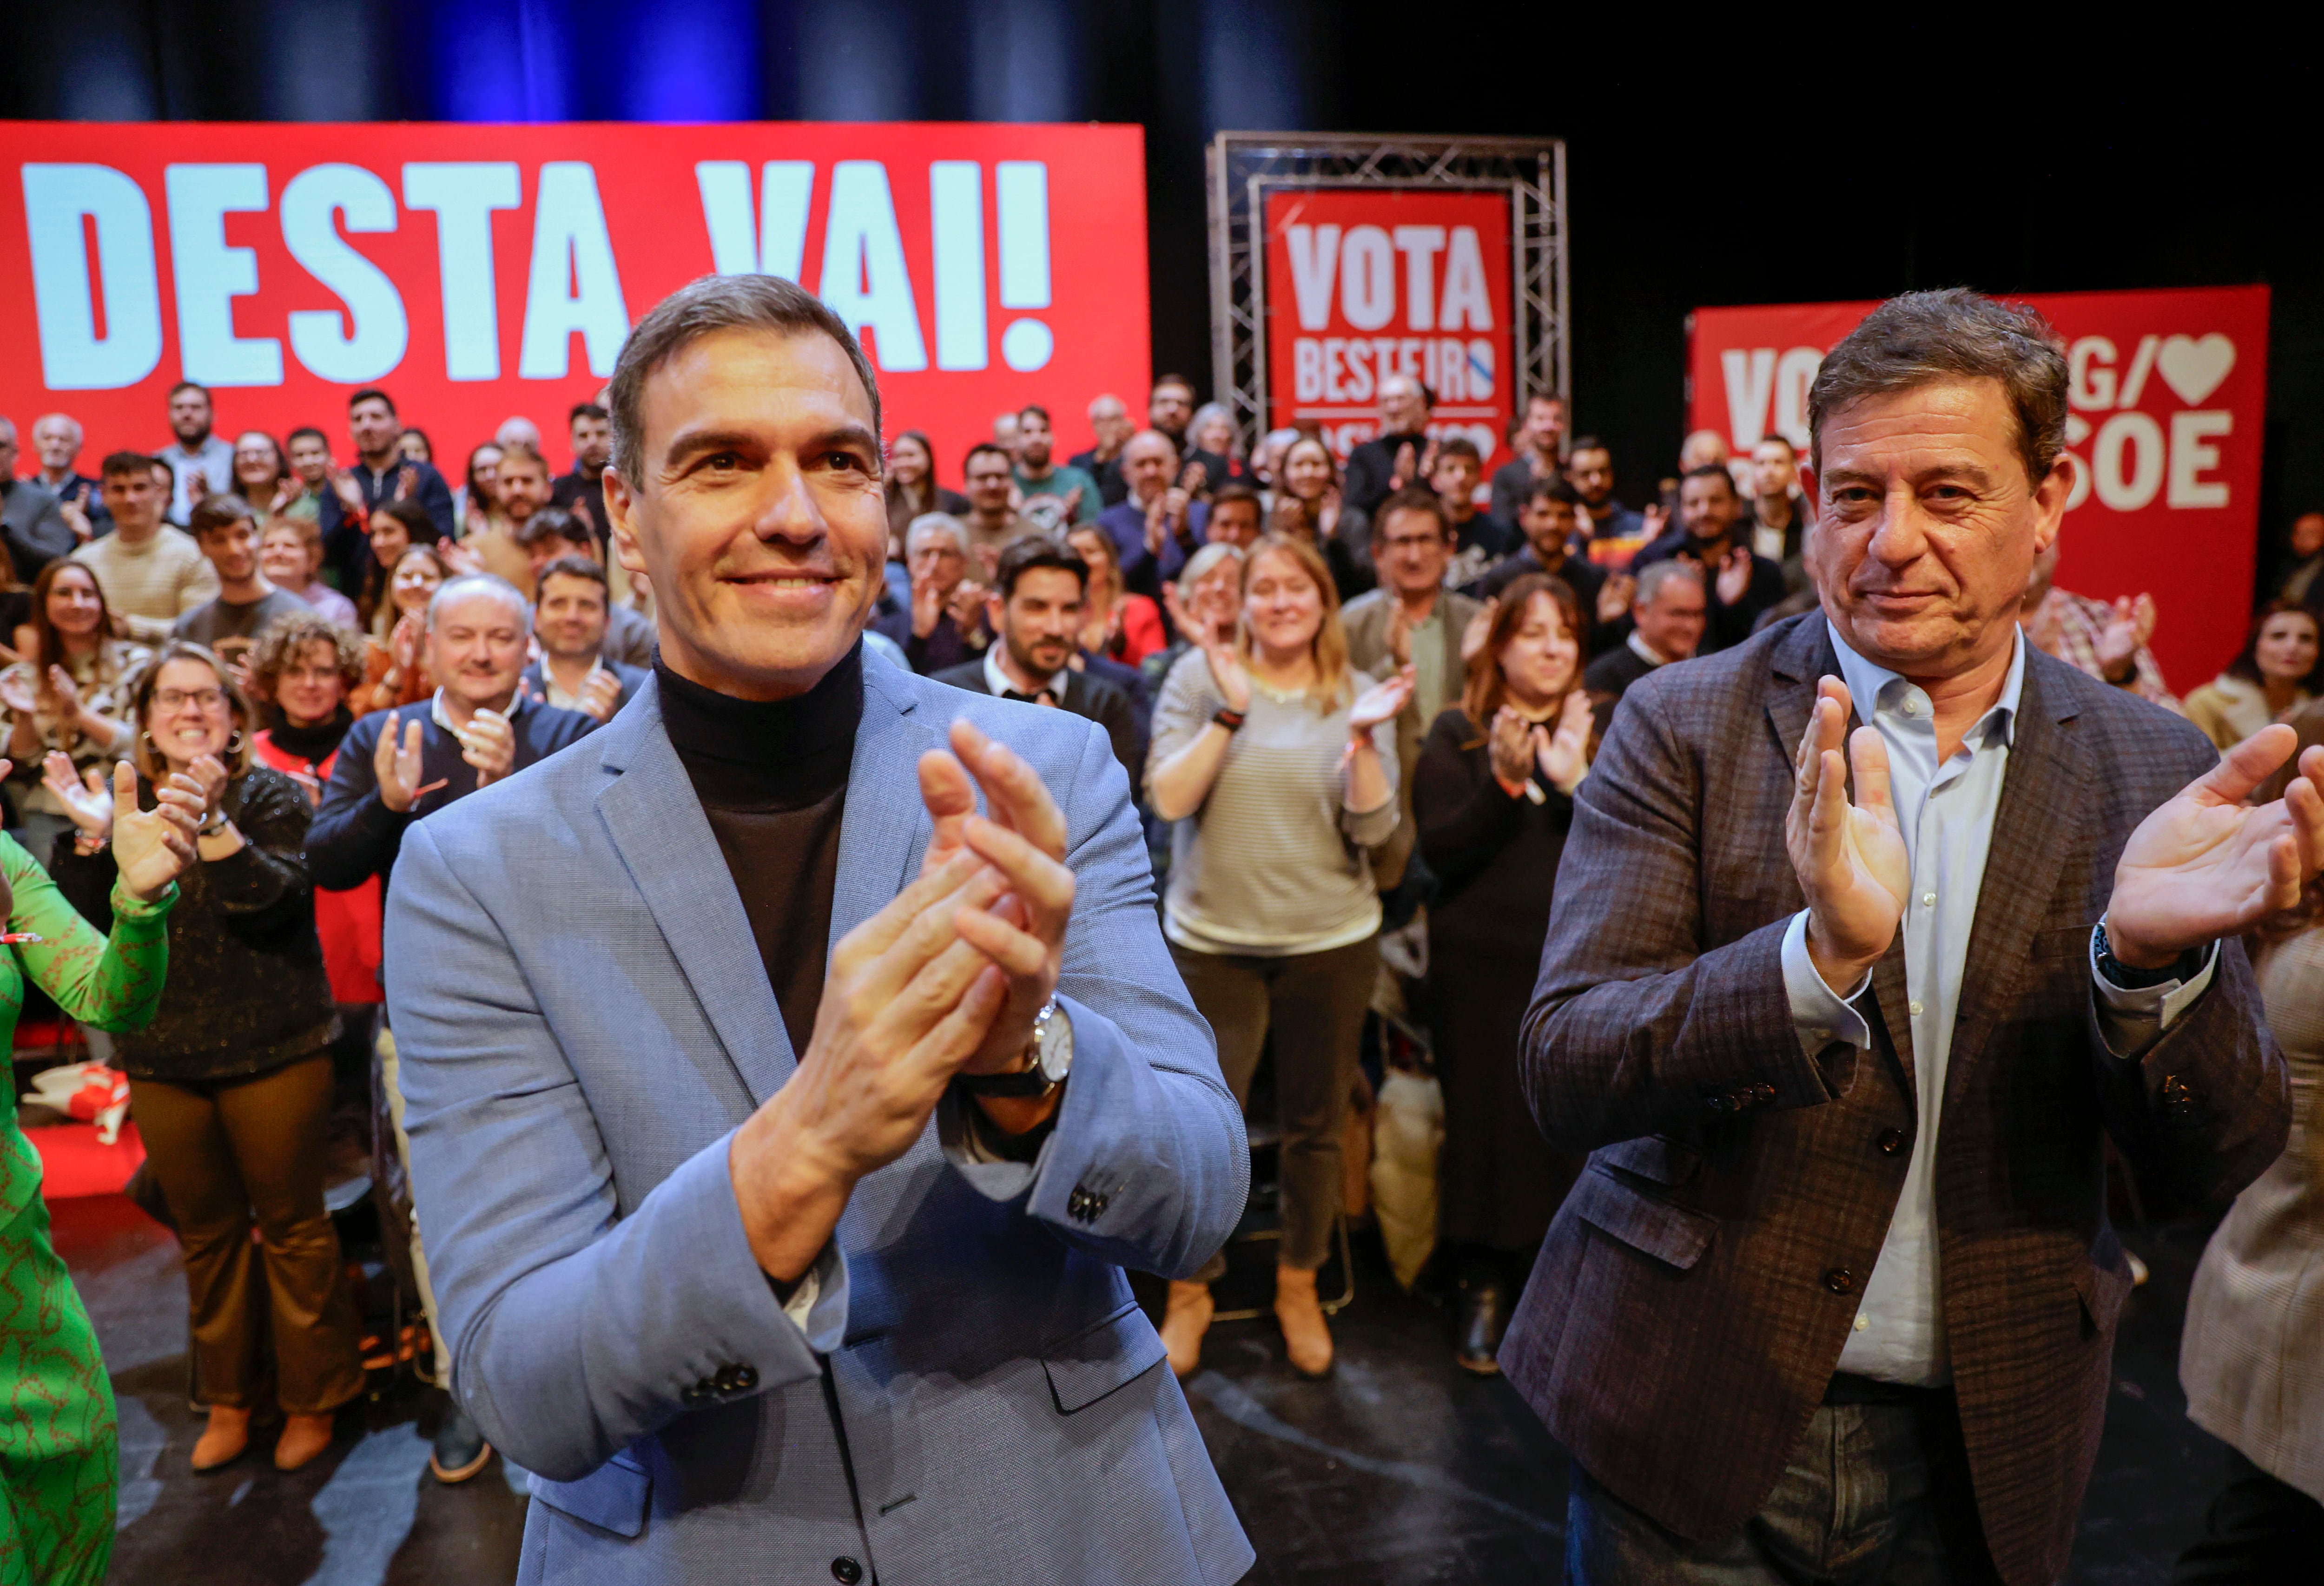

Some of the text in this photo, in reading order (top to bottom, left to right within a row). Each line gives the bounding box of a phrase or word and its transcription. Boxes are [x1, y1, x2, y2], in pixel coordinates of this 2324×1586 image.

[21, 160, 1054, 389] DESTA VAI!
[1286, 224, 1494, 331] VOTA
[1722, 347, 1824, 451] VO
